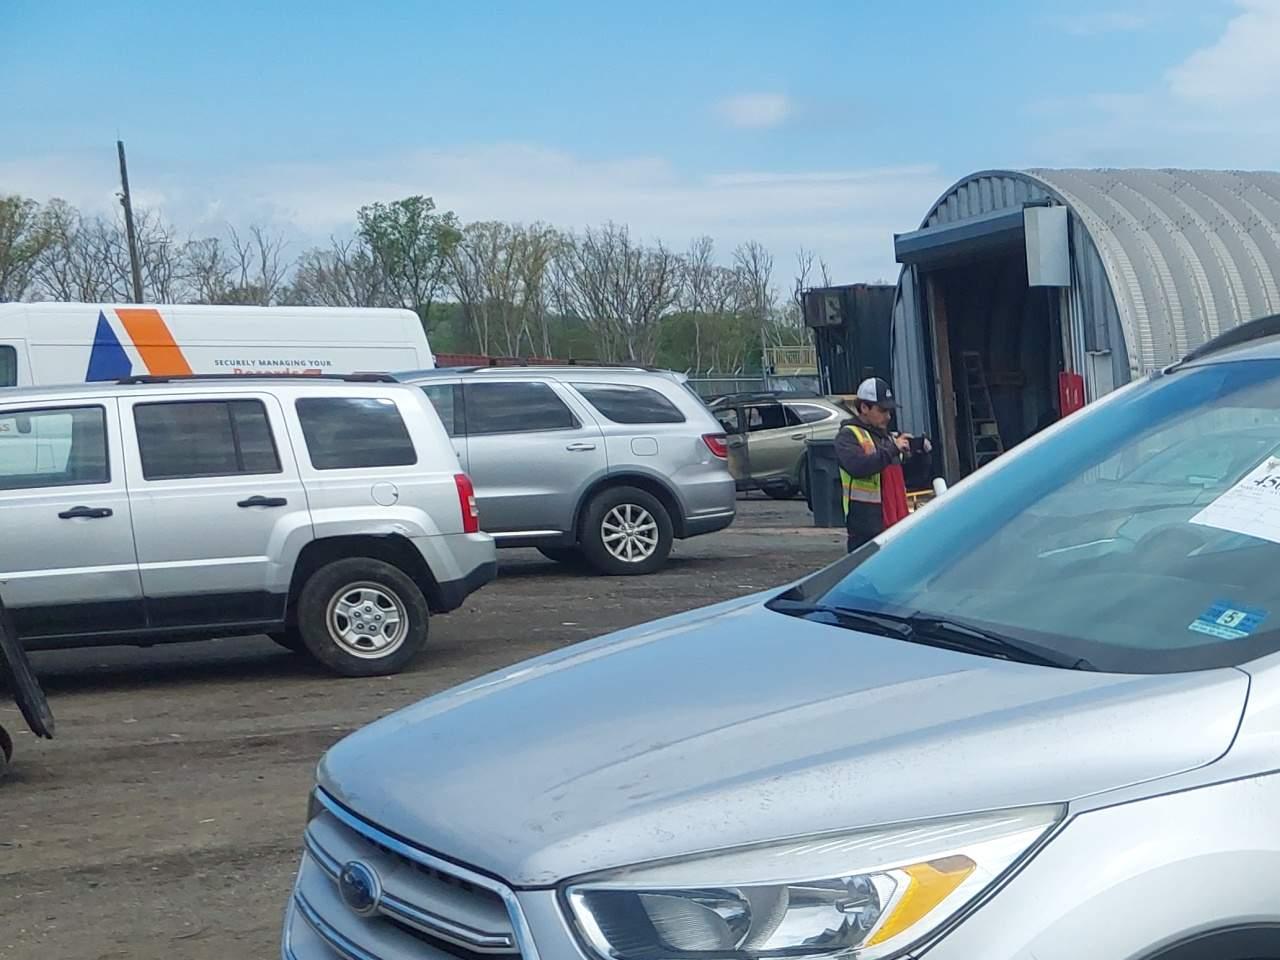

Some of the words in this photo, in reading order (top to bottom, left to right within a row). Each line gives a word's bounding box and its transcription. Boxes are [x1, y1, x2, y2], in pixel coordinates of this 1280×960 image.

[214, 359, 256, 367] SECURELY
[258, 359, 307, 367] MANAGING
[309, 359, 332, 367] YOUR
[1223, 611, 1239, 624] 5
